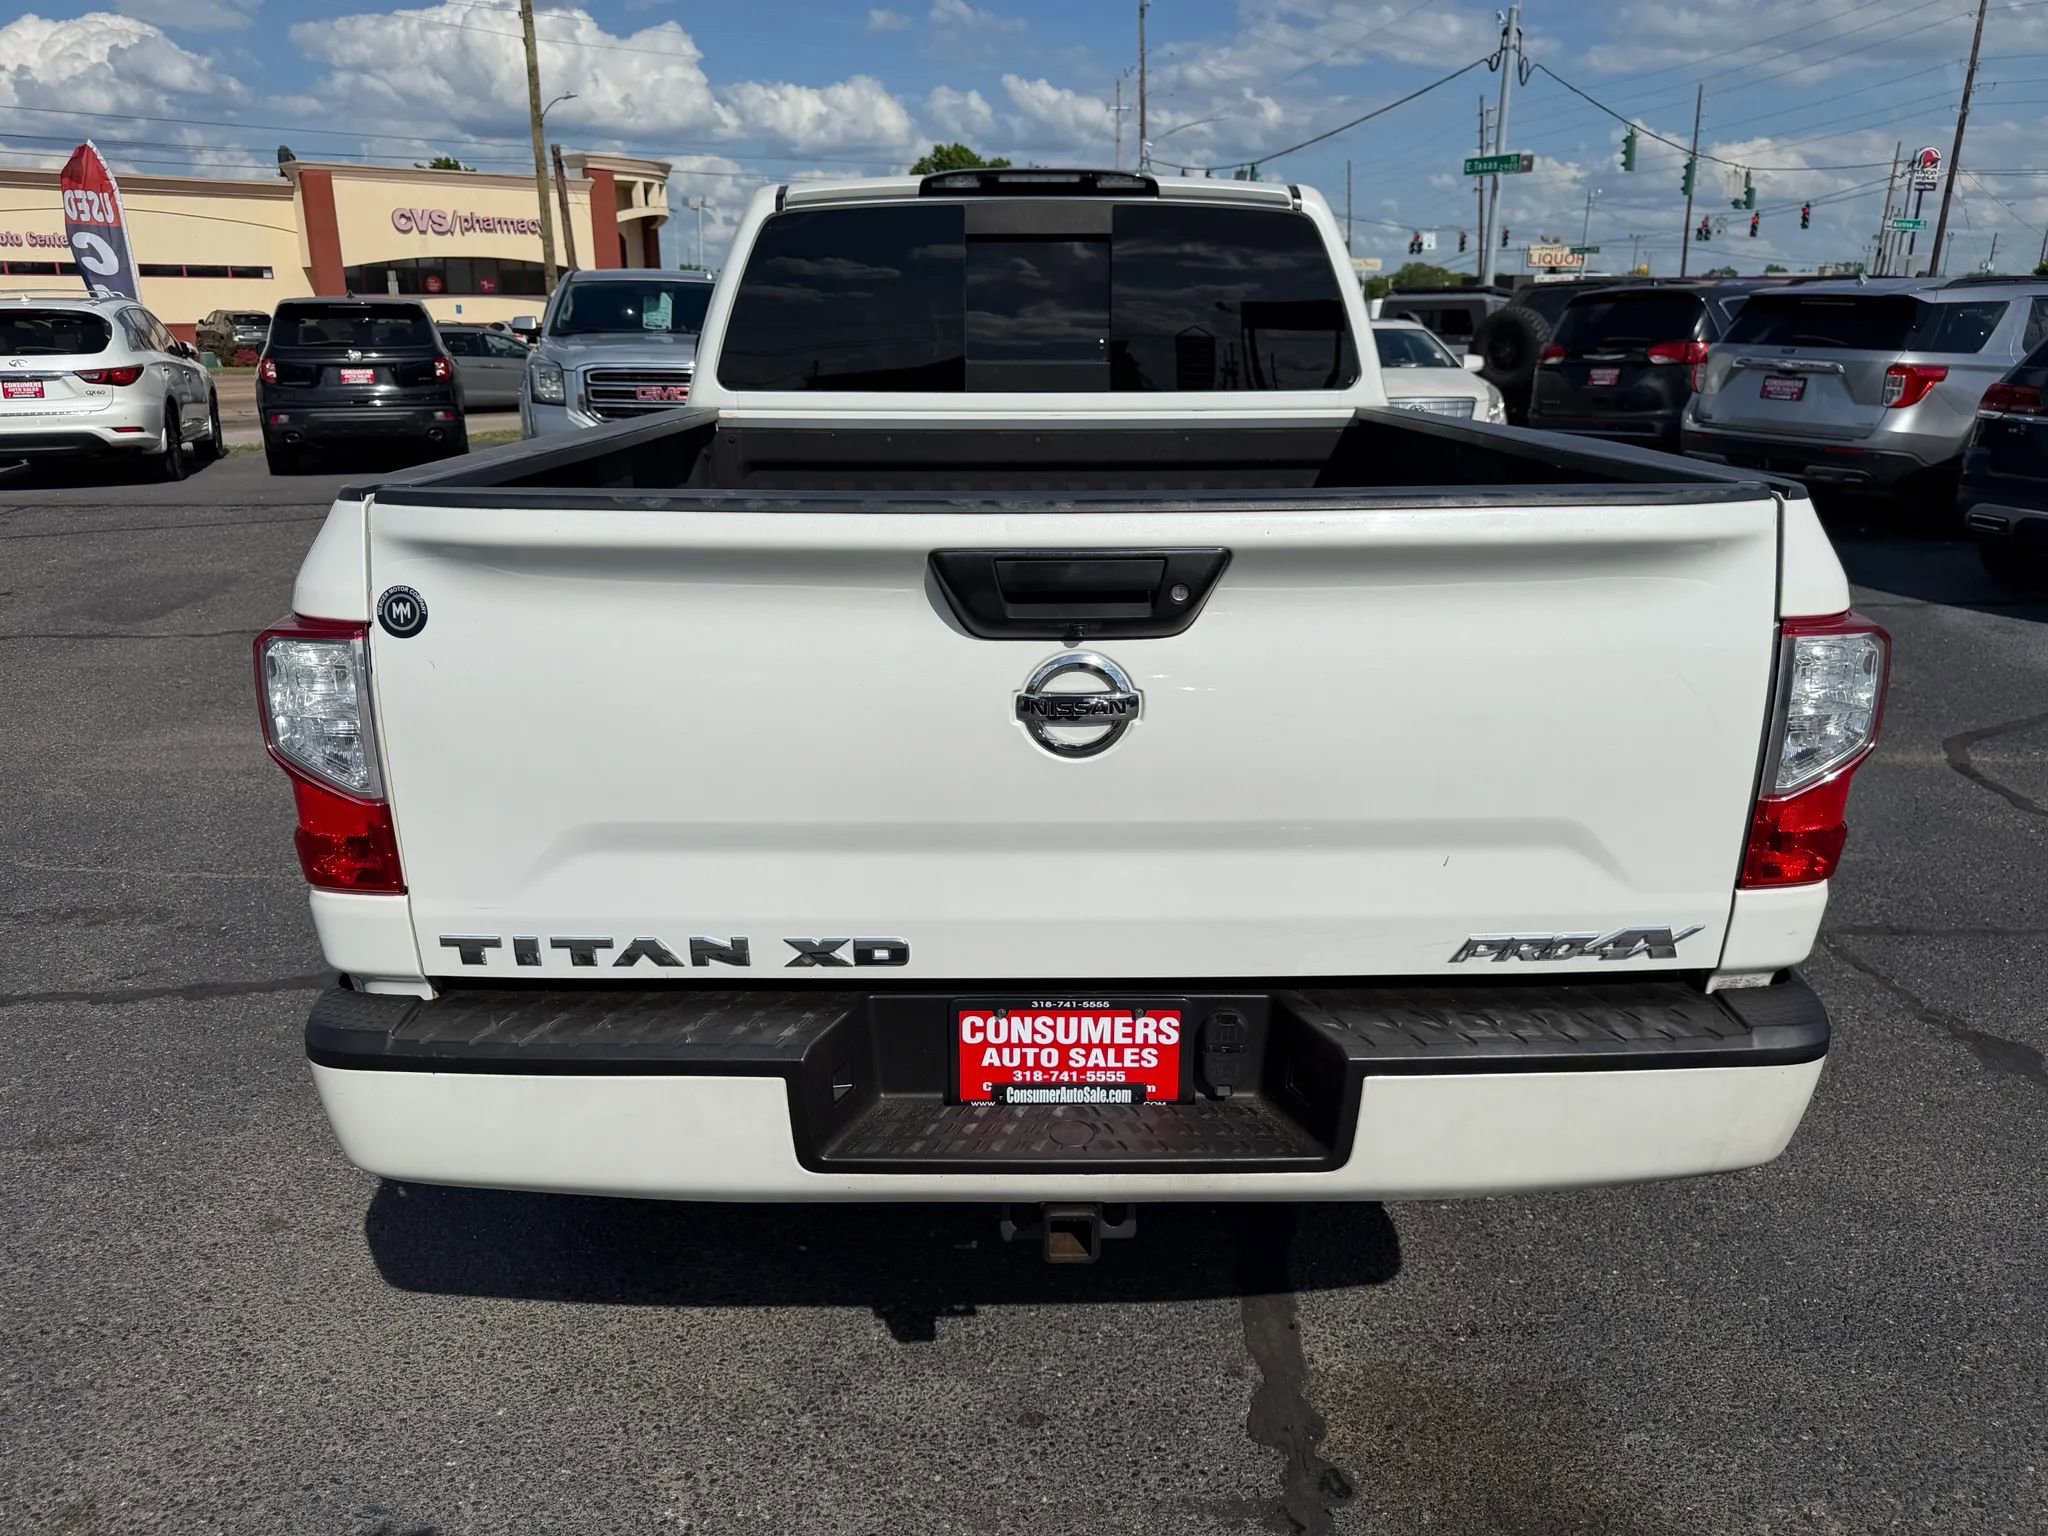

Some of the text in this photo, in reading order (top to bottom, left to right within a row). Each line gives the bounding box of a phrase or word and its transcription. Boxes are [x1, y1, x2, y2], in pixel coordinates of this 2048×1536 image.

[26, 231, 69, 247] Cente
[636, 386, 690, 401] GMC
[388, 586, 409, 594] MOTOR
[409, 589, 427, 615] COMPANY
[1029, 699, 1127, 717] NISSAN
[439, 934, 911, 968] TITAN XD
[961, 1016, 1180, 1045] CONSUMERS
[981, 1048, 1158, 1068] AUTO SALES
[1012, 1070, 1126, 1082] 318-741-5555
[1006, 1086, 1132, 1104] ConsumerAutoSale.com
